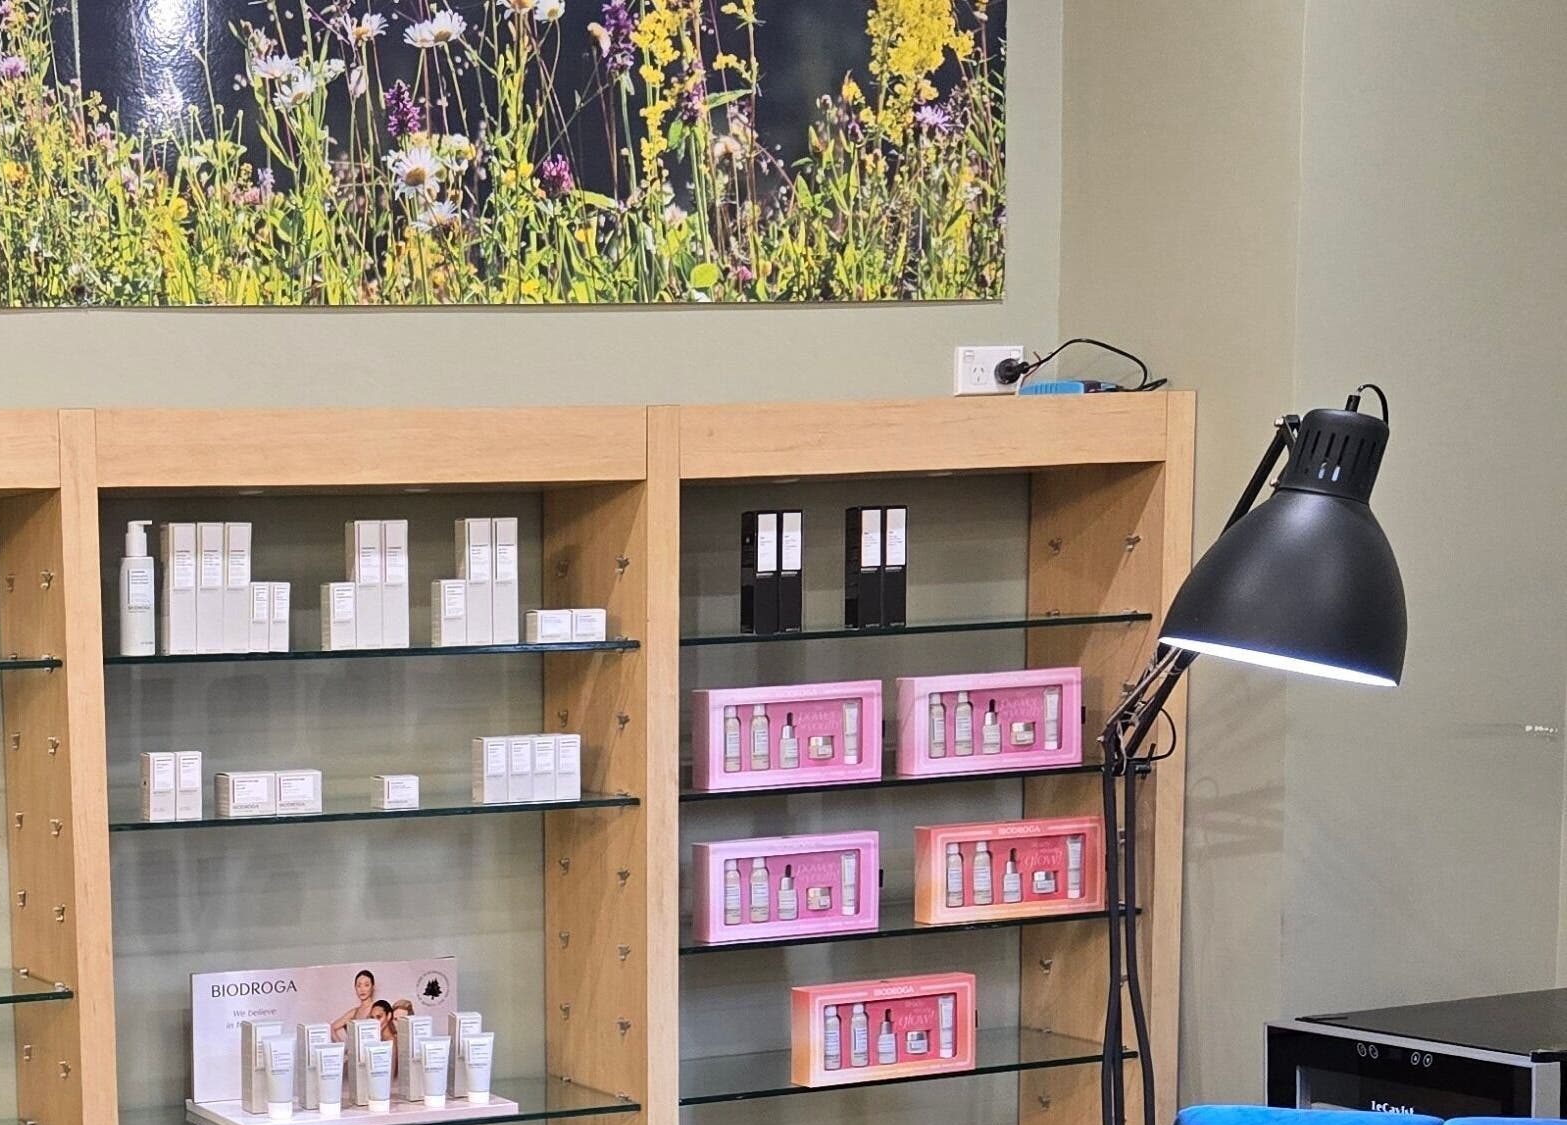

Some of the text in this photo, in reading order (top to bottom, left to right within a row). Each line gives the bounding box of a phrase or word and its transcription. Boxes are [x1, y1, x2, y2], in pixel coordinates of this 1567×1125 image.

[211, 980, 297, 998] BIODROGA
[233, 1008, 277, 1018] We believe
